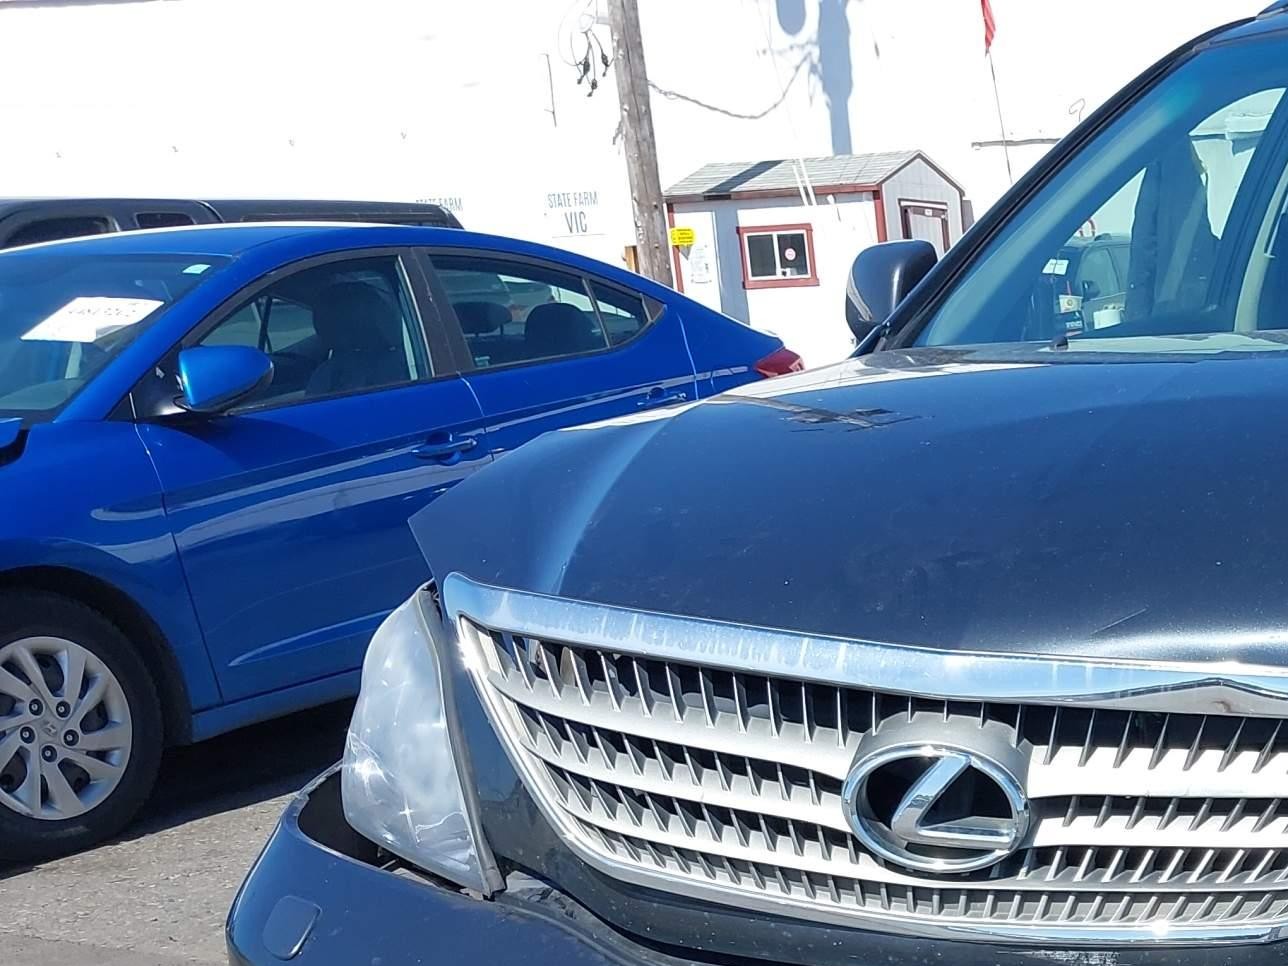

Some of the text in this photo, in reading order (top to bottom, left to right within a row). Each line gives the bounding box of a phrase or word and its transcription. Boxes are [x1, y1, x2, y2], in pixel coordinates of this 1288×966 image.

[547, 191, 599, 209] STATE FARM
[564, 210, 588, 234] VIC
